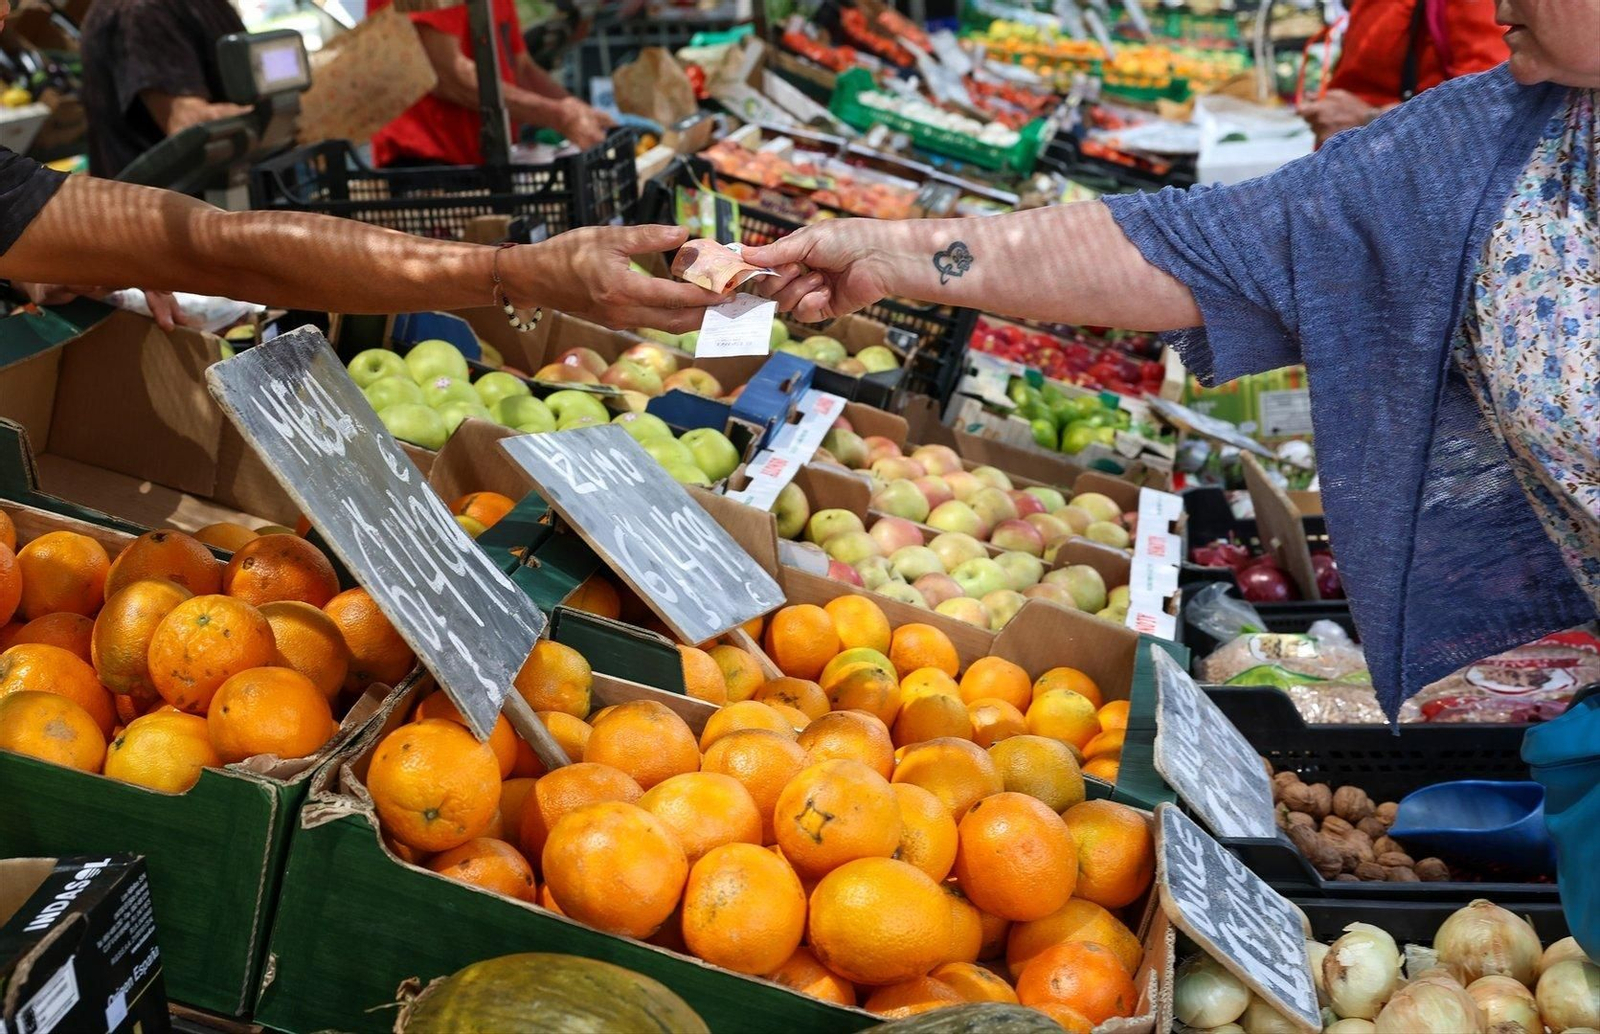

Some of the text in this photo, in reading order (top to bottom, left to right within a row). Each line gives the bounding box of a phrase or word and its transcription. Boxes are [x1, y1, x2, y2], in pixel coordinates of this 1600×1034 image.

[250, 371, 359, 465] MESA
[551, 448, 645, 494] ZUMO
[1172, 814, 1219, 938] DULCE
